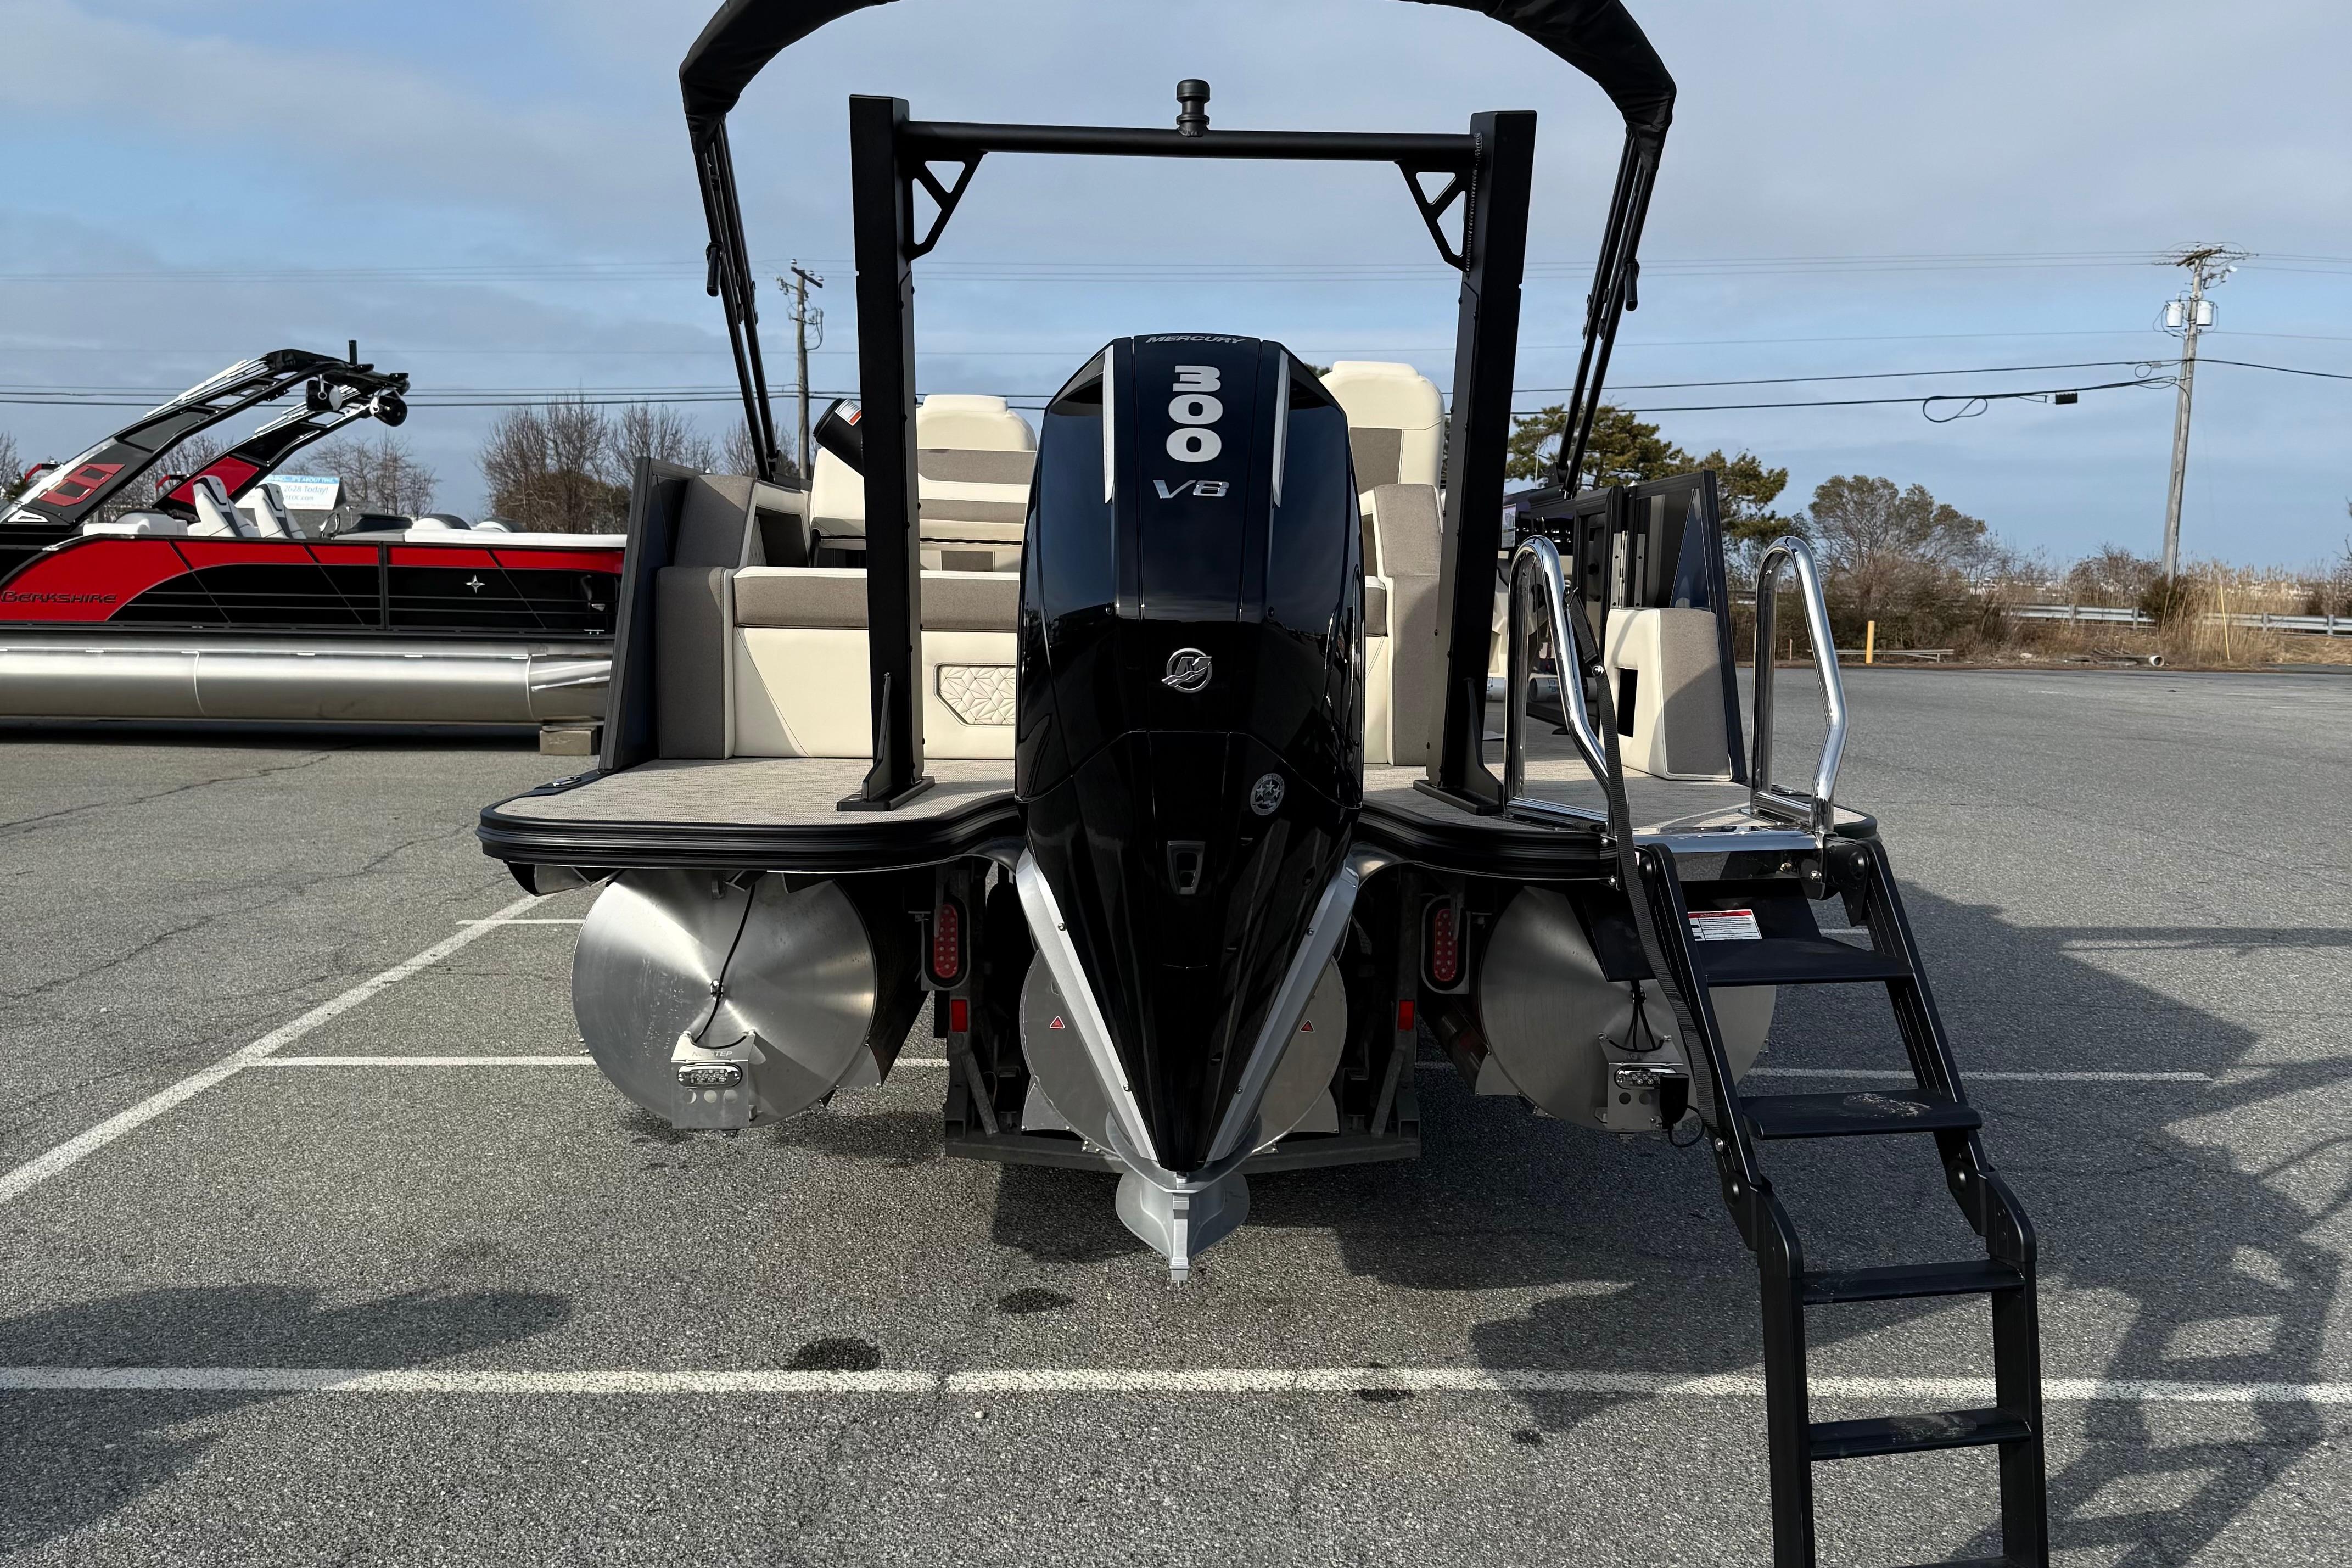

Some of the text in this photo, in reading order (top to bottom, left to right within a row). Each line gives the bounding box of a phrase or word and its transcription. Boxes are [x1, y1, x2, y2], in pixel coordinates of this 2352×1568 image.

[1146, 335, 1246, 344] MERCURY
[1166, 365, 1223, 462] 300
[1153, 479, 1230, 499] V8
